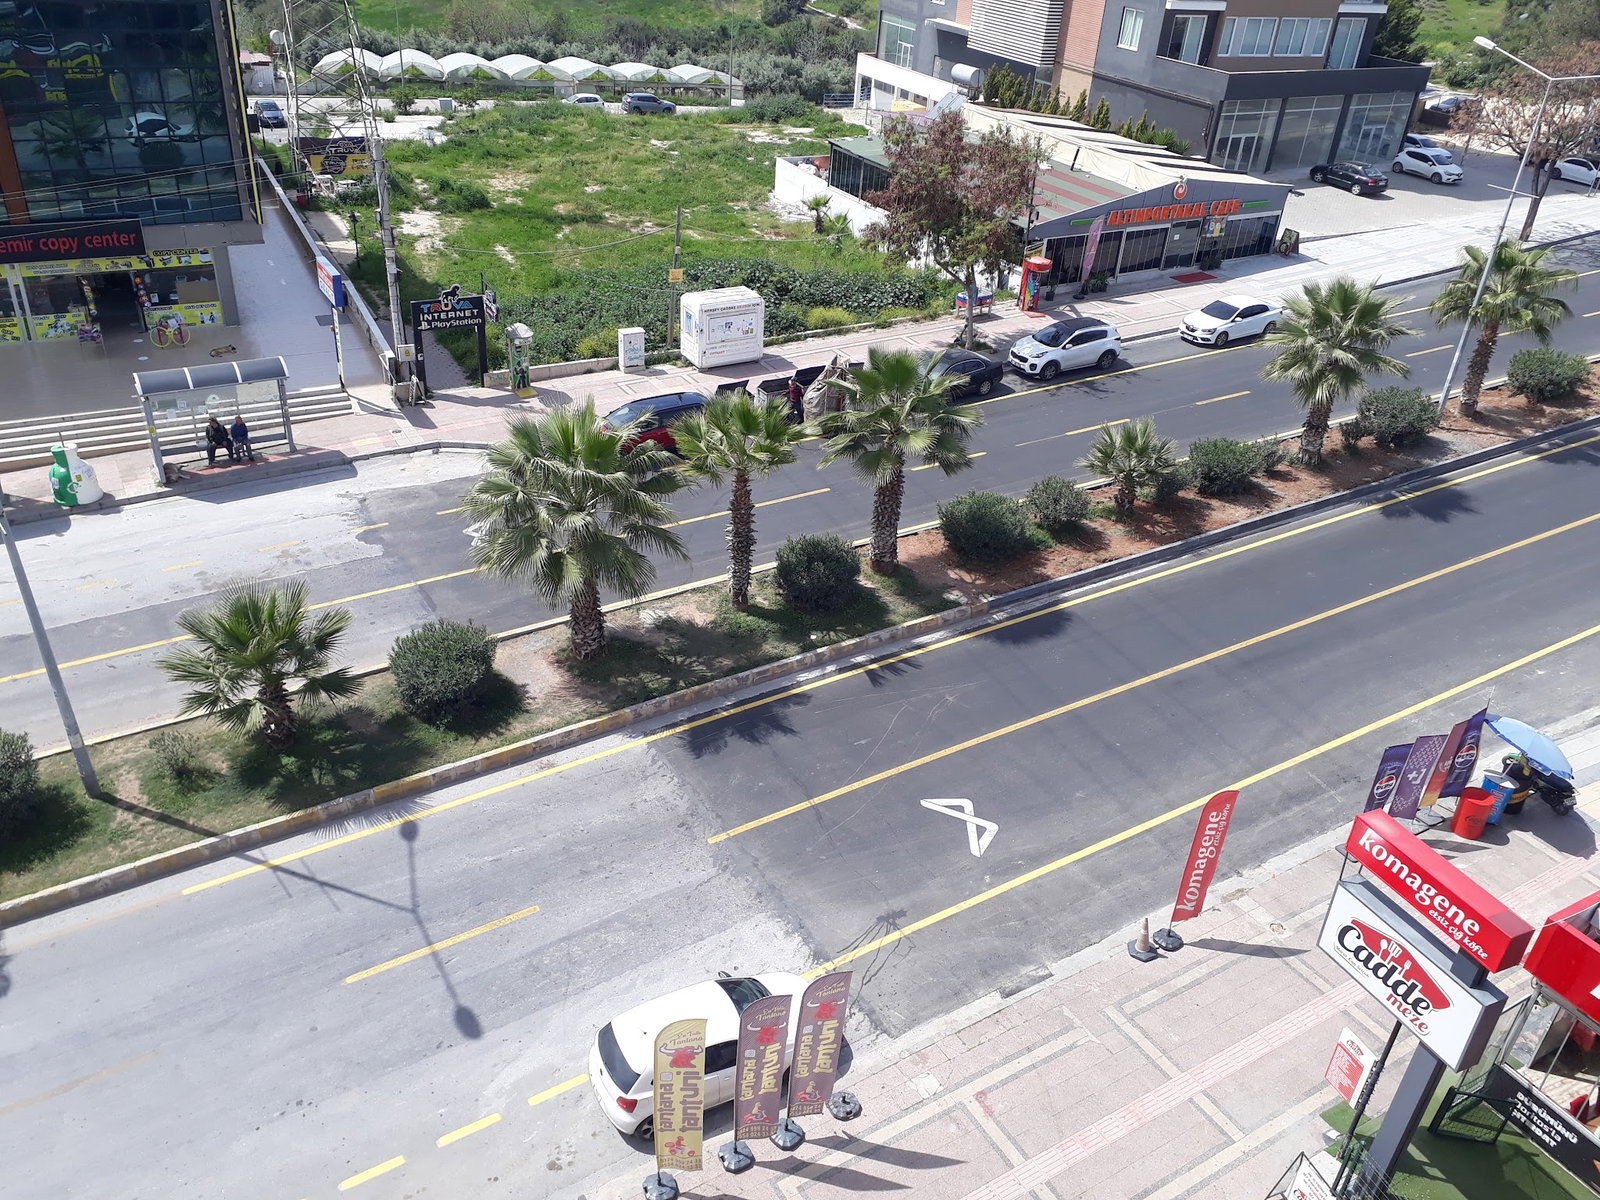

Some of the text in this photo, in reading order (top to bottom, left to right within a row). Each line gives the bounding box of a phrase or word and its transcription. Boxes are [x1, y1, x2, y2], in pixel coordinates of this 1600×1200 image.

[1107, 200, 1241, 226] ALTINPORTAKAL CAFE
[40, 237, 78, 254] copy
[84, 232, 136, 248] center
[173, 248, 199, 256] CENTER
[420, 301, 473, 312] TRUVA
[420, 310, 479, 320] INTERNET
[432, 318, 482, 328] PlayStation
[1176, 811, 1222, 911] komagene
[1358, 827, 1480, 936] komagene
[1428, 908, 1488, 960] etsiz çiğ köfte
[1338, 924, 1430, 1016] Cadde
[1386, 994, 1428, 1032] meze
[794, 1034, 813, 1078] tantana
[813, 1020, 839, 1073] tantuni
[740, 1060, 756, 1101] tantana
[758, 1042, 782, 1096] tantuni
[658, 1083, 675, 1132] tantana
[676, 1070, 703, 1132] tantuni
